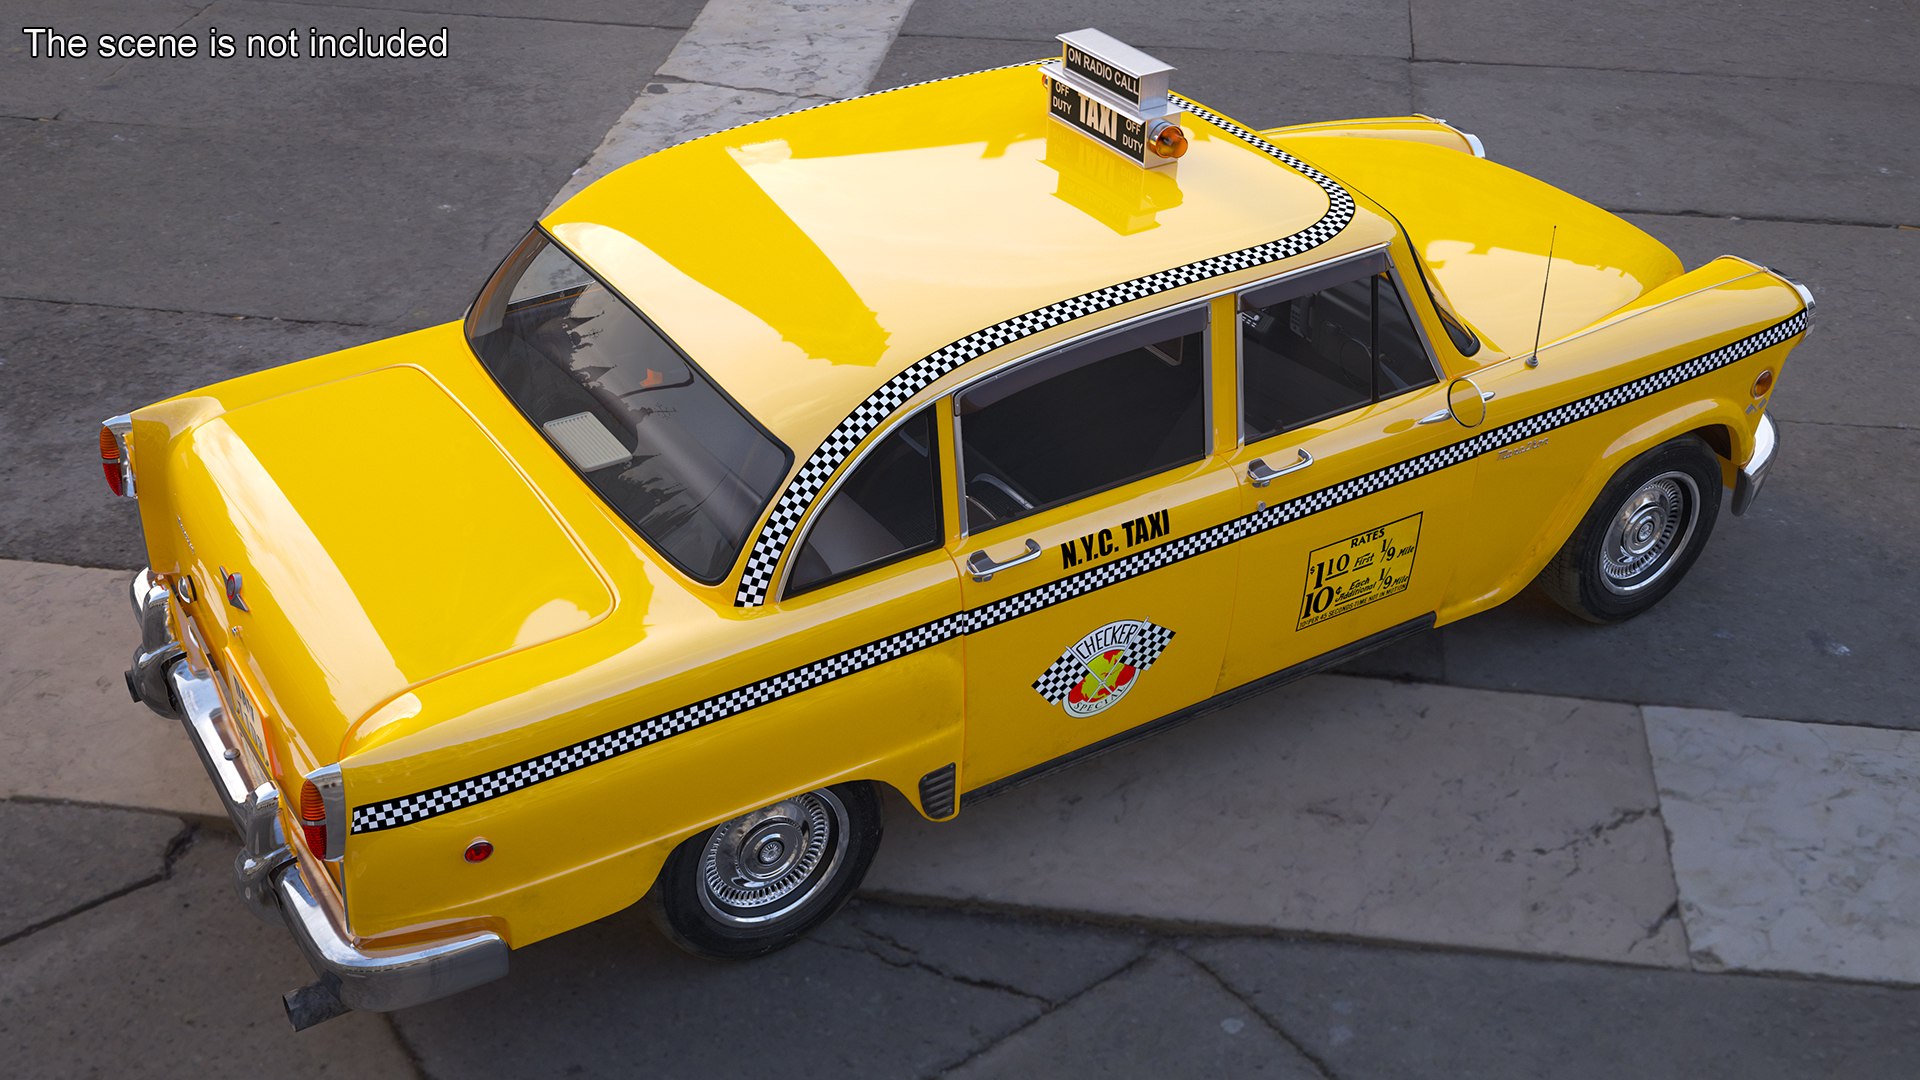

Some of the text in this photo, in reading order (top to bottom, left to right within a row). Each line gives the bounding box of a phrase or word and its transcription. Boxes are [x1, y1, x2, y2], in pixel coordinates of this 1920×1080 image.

[1068, 48, 1139, 96] ON RADIO CALL
[1055, 82, 1070, 97] OFF
[1052, 96, 1073, 115] DUTY
[1077, 93, 1118, 141] TAXI
[1125, 119, 1141, 135] OFF
[1123, 134, 1144, 154] DUTY
[1060, 509, 1170, 569] N.Y.C. TAXI
[1351, 528, 1385, 549] RATES
[1354, 553, 1375, 567] First
[1397, 545, 1415, 558] Mile
[1335, 582, 1376, 602] Additional
[1391, 575, 1409, 587] Mile
[1349, 577, 1370, 590] Each
[1076, 623, 1139, 660] CHECKER
[1074, 685, 1126, 712] SPECIAL
